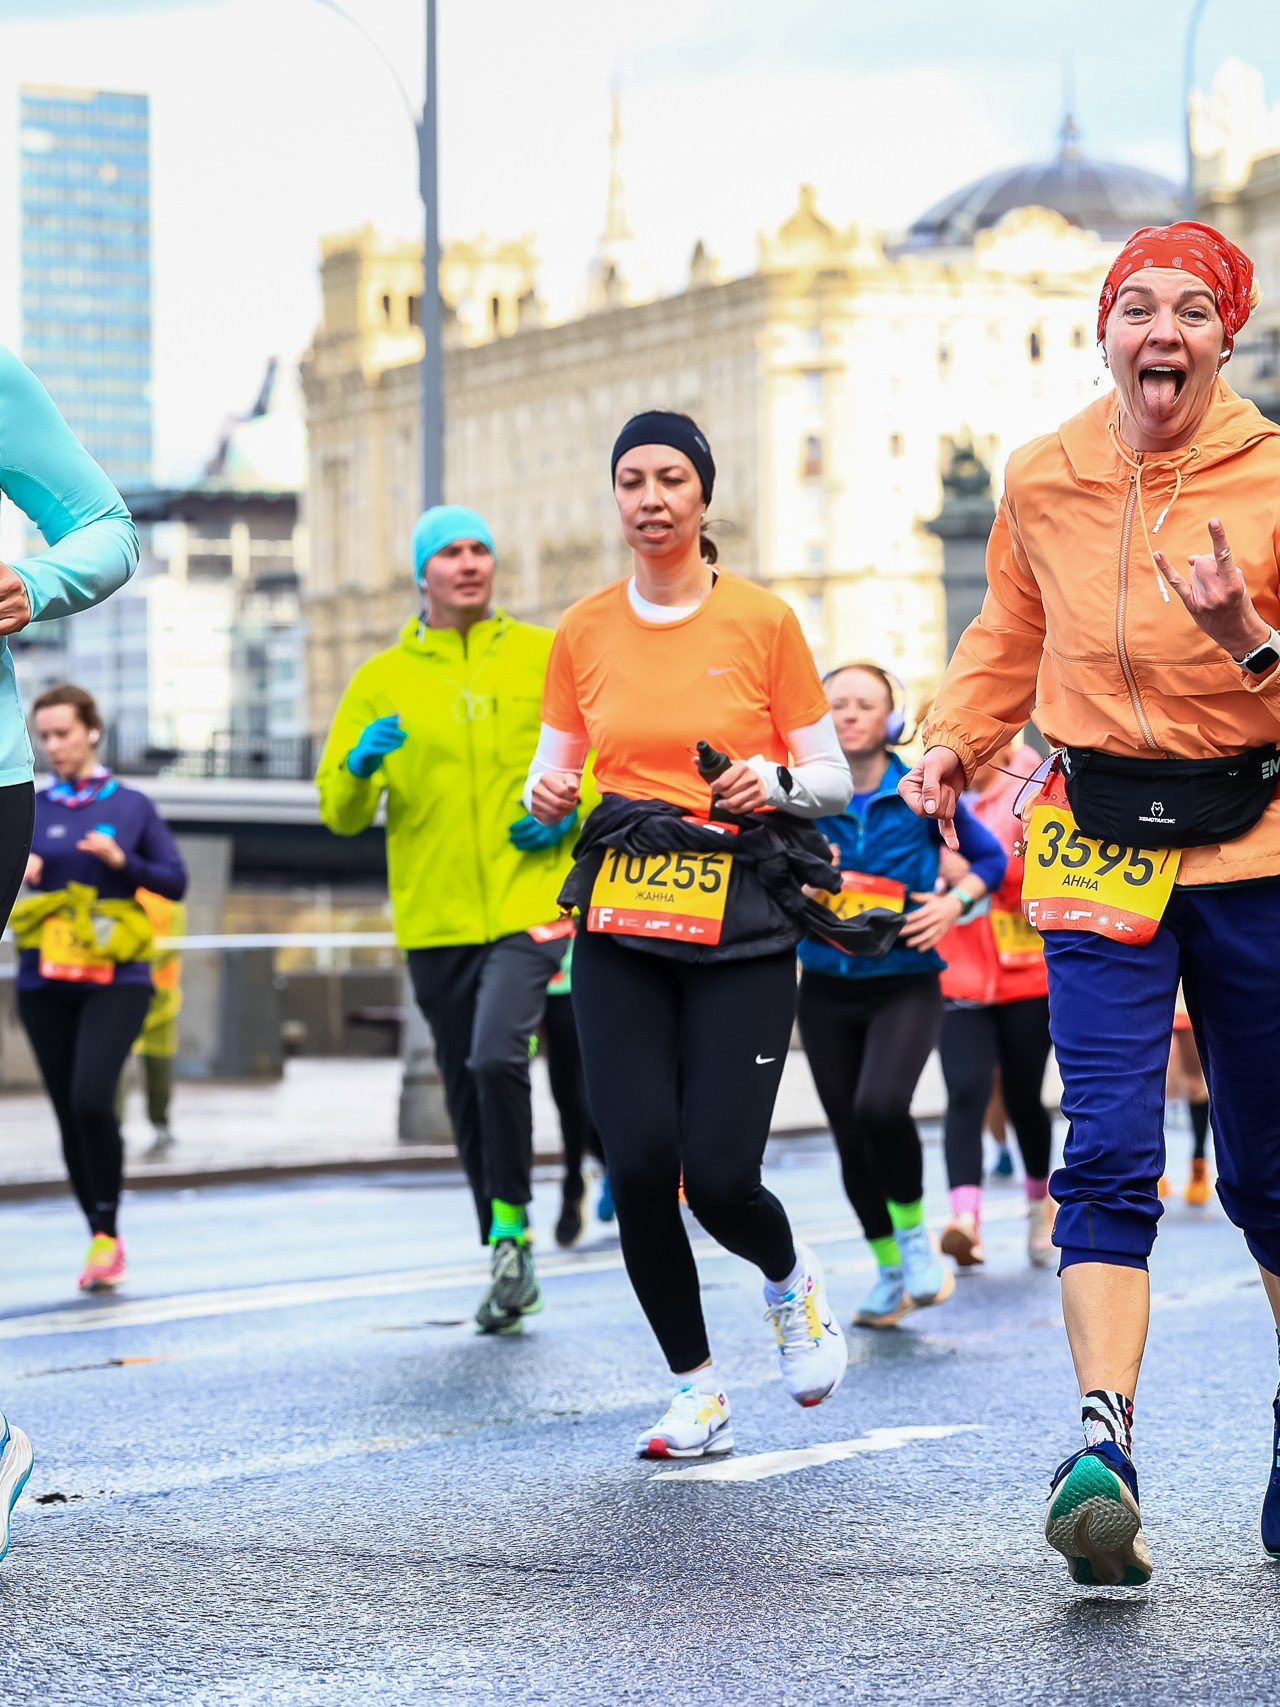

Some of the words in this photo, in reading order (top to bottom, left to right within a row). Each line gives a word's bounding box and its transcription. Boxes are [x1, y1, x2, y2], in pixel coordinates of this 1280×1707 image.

[1037, 820, 1155, 887] 3595
[608, 850, 725, 894] 10255
[1061, 873, 1099, 892] АННА
[635, 889, 675, 904] ЖАННА
[598, 907, 614, 930] F
